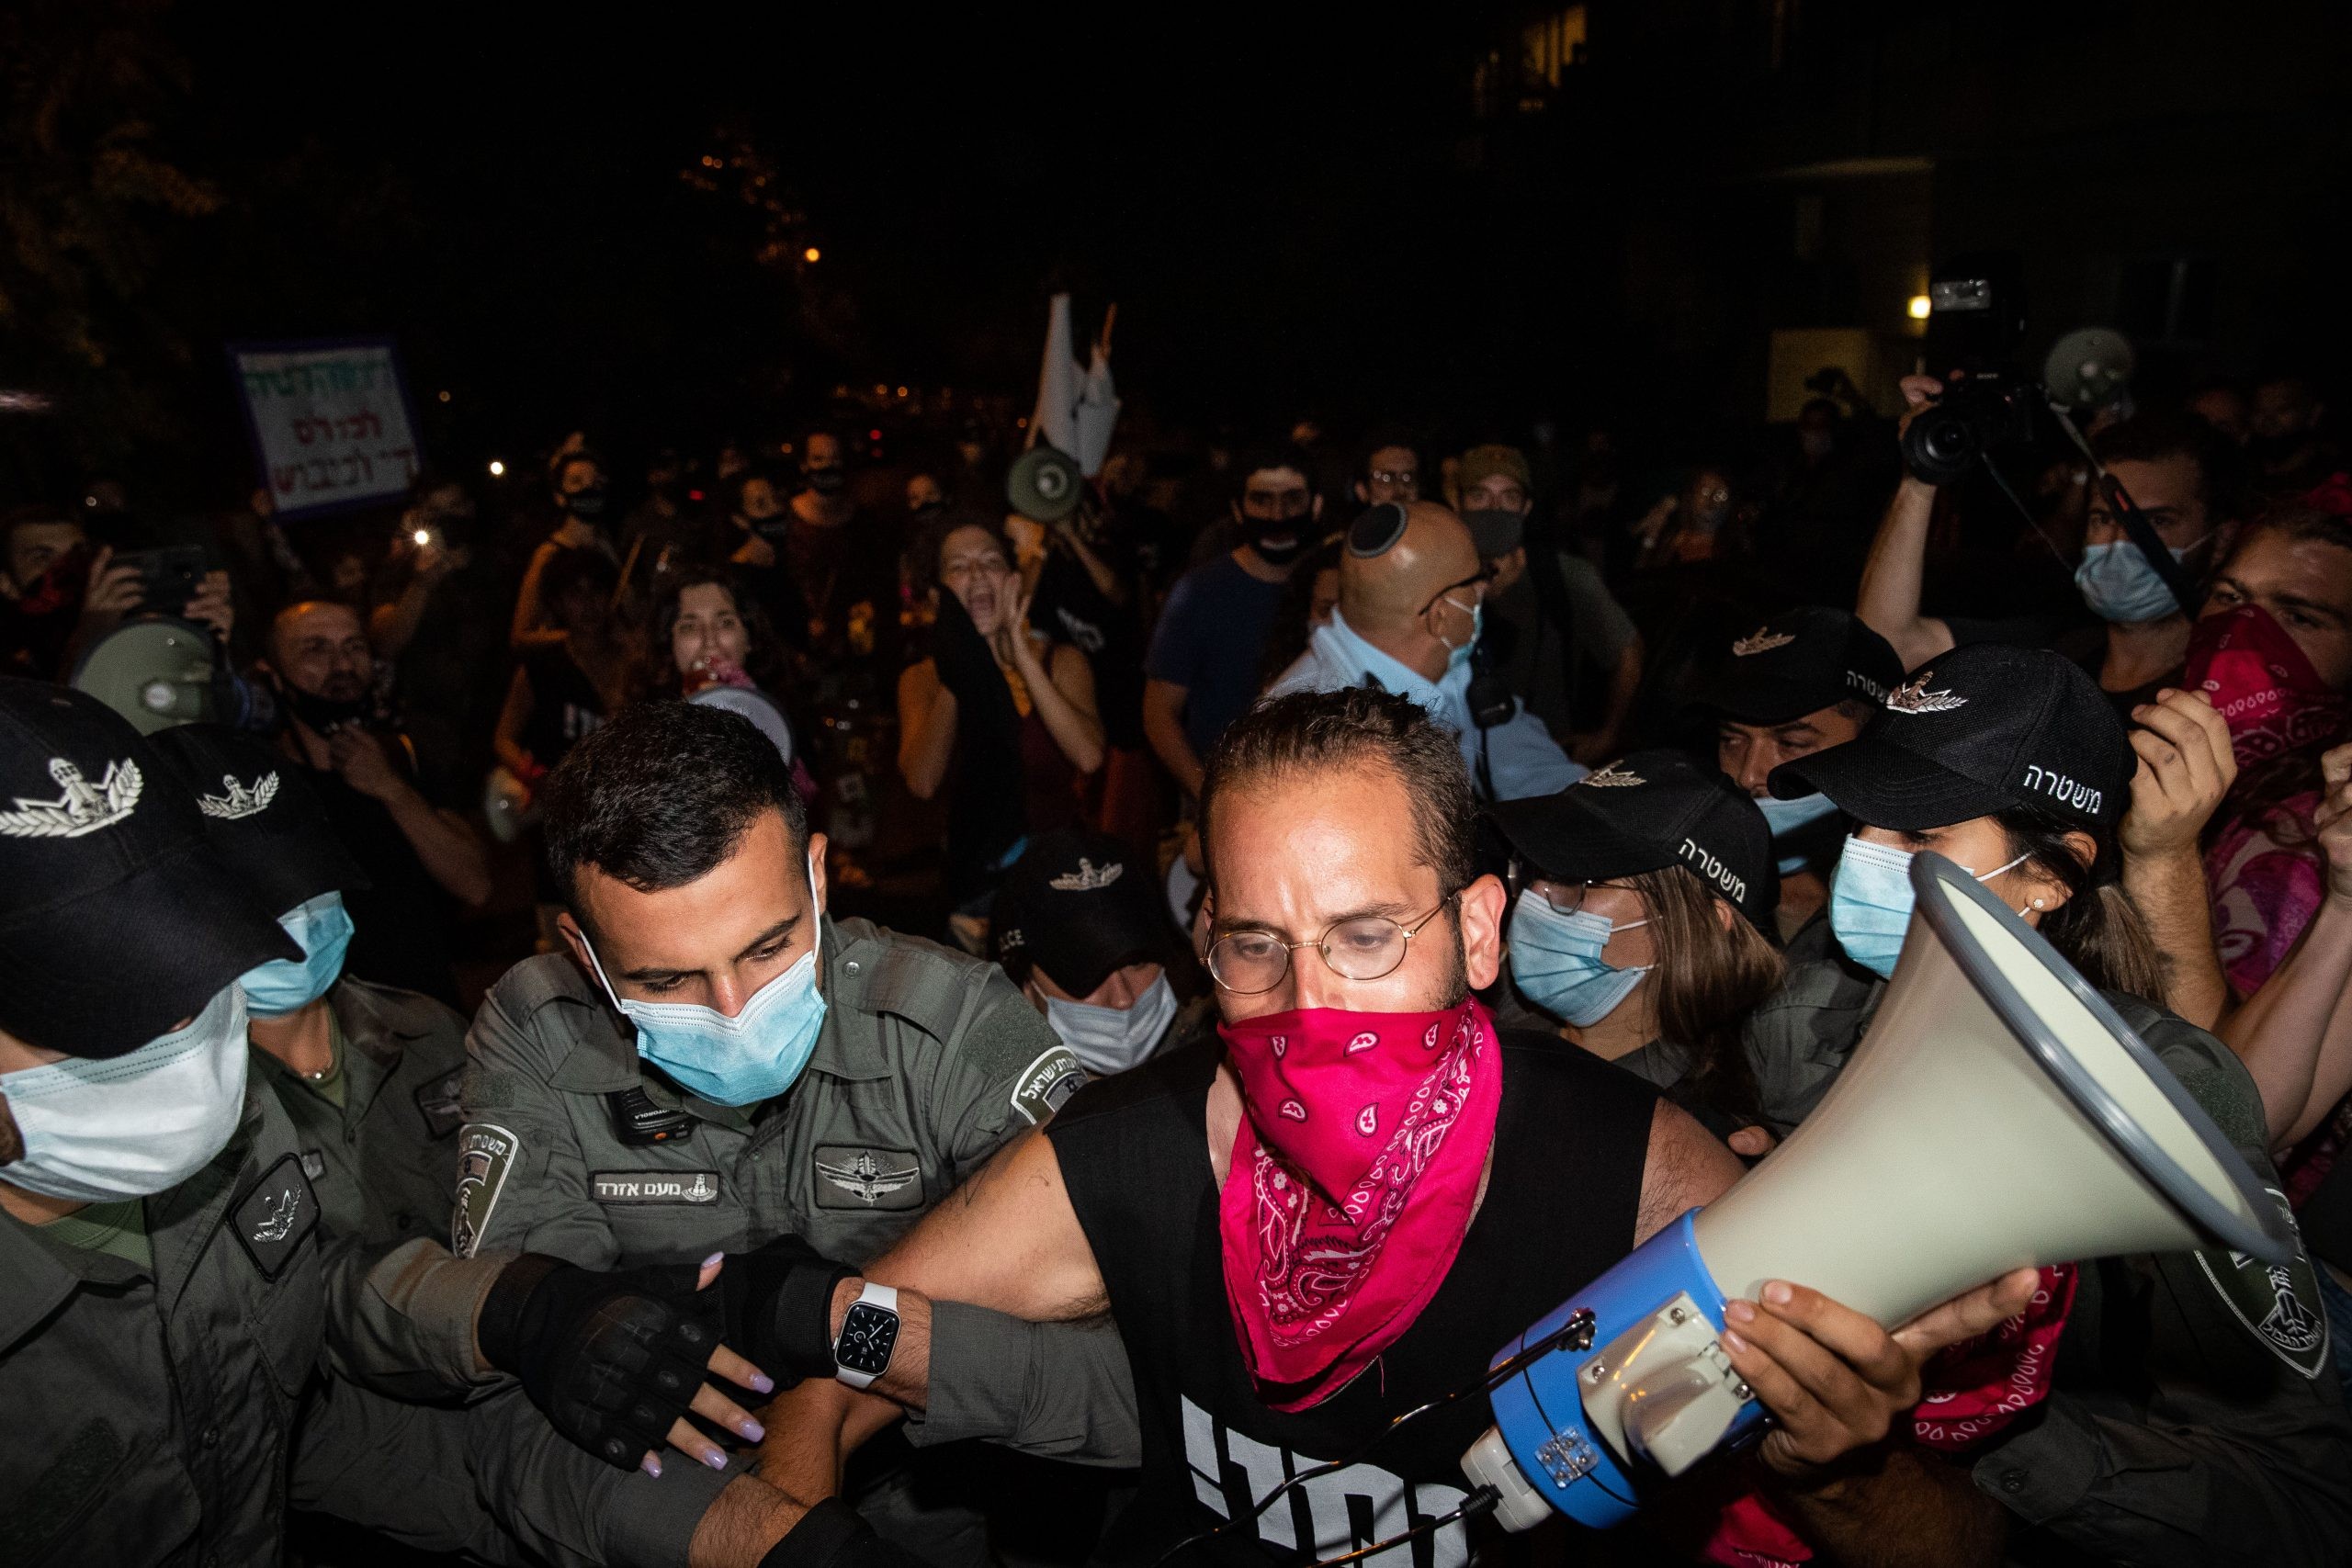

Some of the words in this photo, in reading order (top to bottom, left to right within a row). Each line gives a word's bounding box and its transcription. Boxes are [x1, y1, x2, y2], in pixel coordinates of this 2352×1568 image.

[2023, 764, 2102, 814] משטרה
[1679, 838, 1747, 904] משטרה
[1020, 1063, 1057, 1100] ישראל
[634, 1110, 670, 1120] OTOROLA
[644, 1182, 681, 1197] מעם
